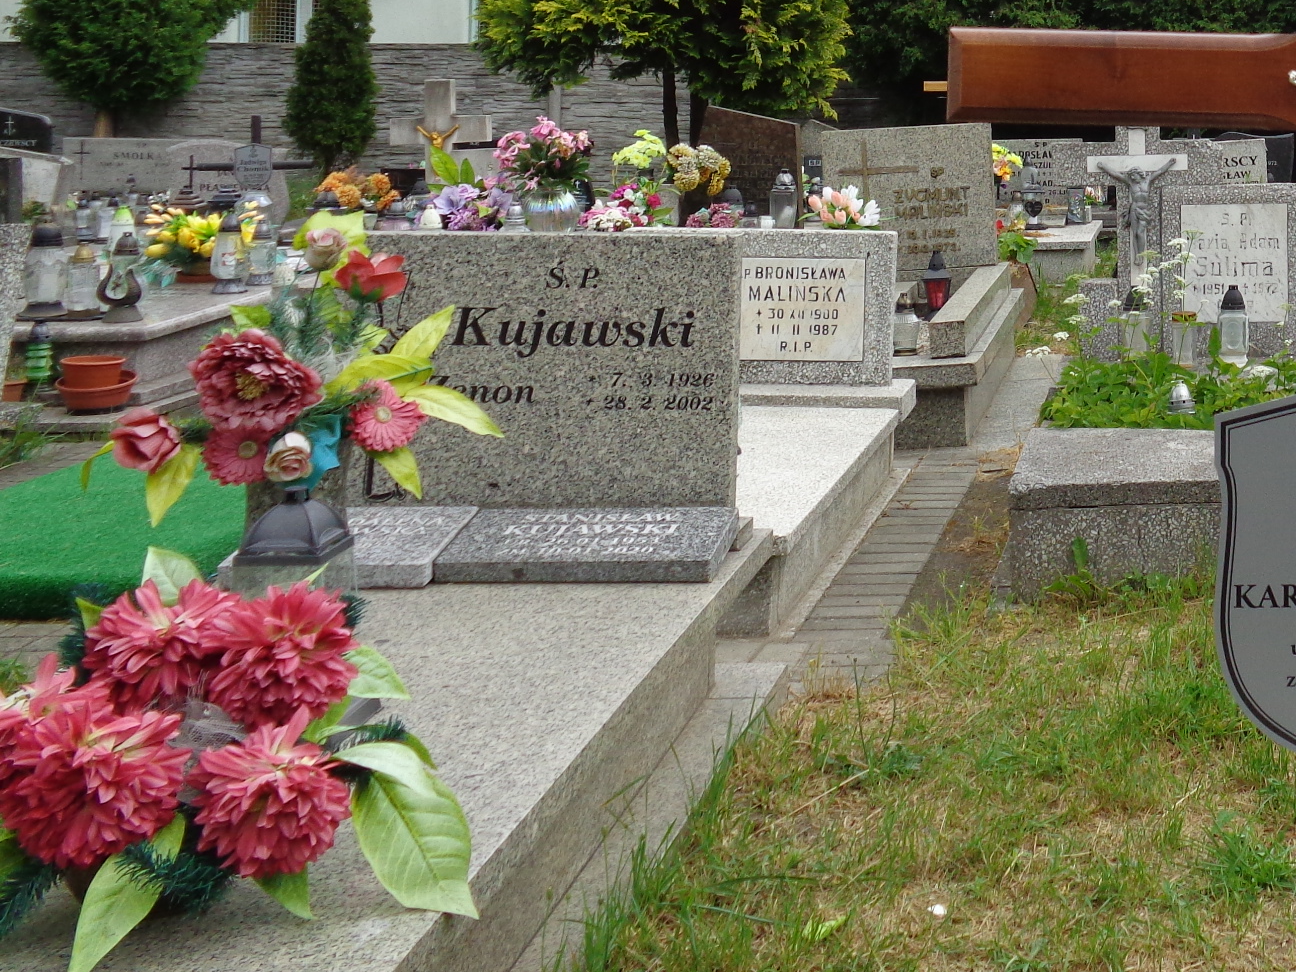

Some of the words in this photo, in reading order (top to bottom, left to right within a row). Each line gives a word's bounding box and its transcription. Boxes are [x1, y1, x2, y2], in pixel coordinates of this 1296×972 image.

[546, 260, 569, 289] Ś.
[579, 267, 599, 289] P.
[755, 267, 846, 280] BRONISŁAWA
[451, 306, 696, 358] Kujawski
[809, 324, 838, 336] 1987
[780, 341, 813, 353] R.I.P.
